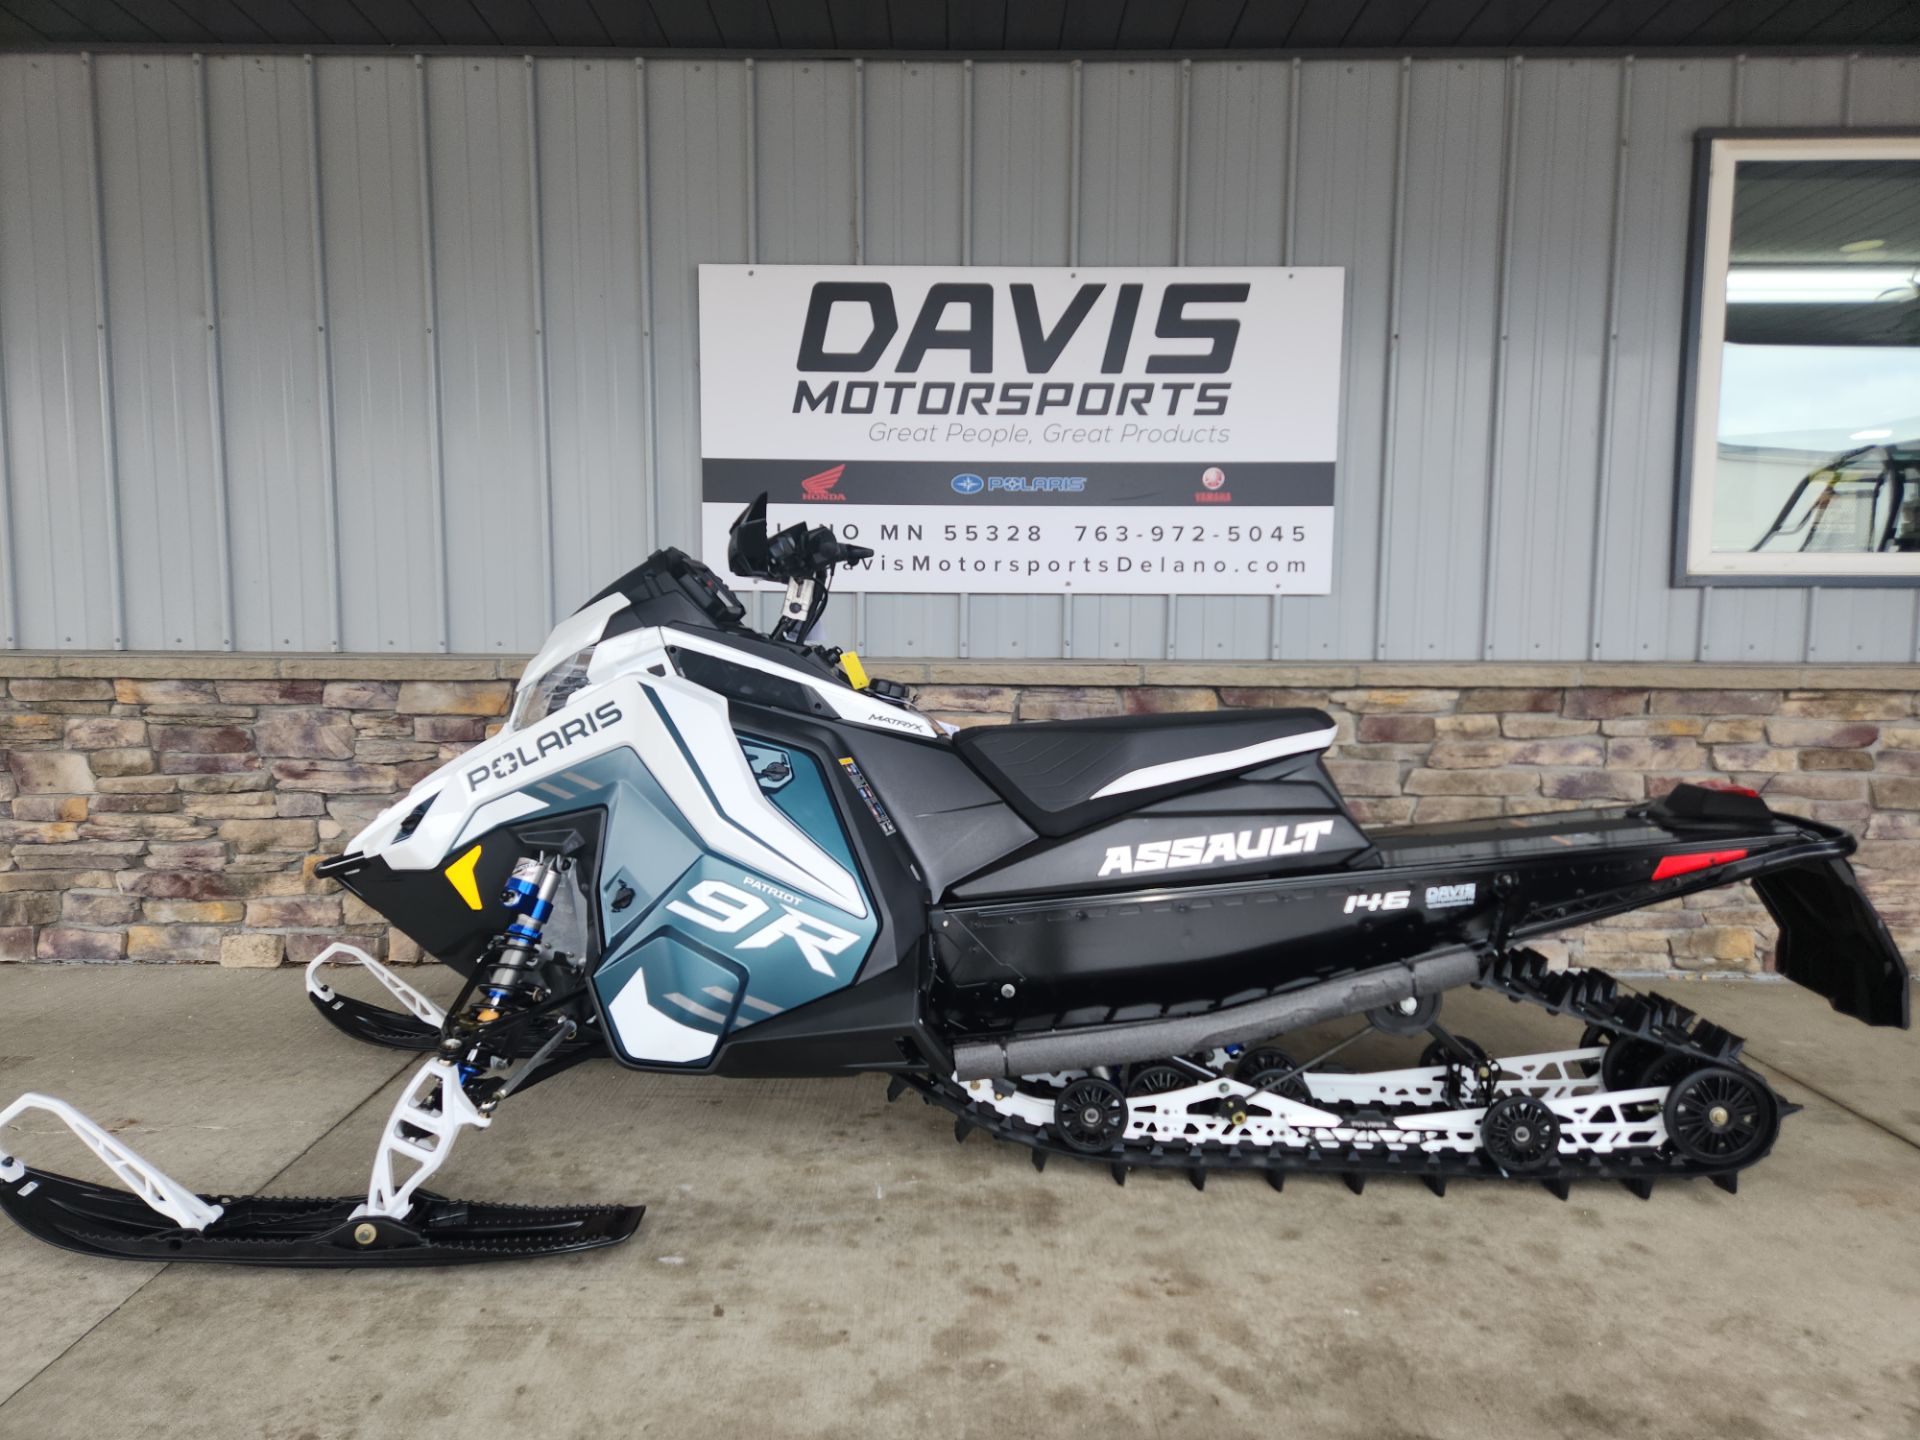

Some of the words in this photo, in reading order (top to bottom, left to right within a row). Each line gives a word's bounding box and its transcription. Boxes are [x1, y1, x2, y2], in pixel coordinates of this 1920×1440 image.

[797, 282, 1251, 374] DAVIS
[793, 380, 1232, 416] MOTORSPORTS
[869, 422, 938, 443] Great
[946, 423, 1033, 447] People,
[1043, 423, 1113, 444] Great
[1120, 423, 1231, 444] Products
[802, 492, 847, 501] HONDA
[987, 476, 1087, 493] POLARIS
[881, 524, 923, 541] MN
[944, 524, 1041, 542] 55328
[1074, 525, 1306, 542] 763-972-5045
[822, 554, 1306, 577] avisMotorsportsDelano.com
[868, 713, 924, 733] MATRYX
[466, 700, 623, 792] POLARIS
[1097, 819, 1335, 878] ASSAULT
[742, 876, 804, 906] PATRIOT
[1343, 890, 1412, 915] 146
[664, 879, 862, 978] 9R
